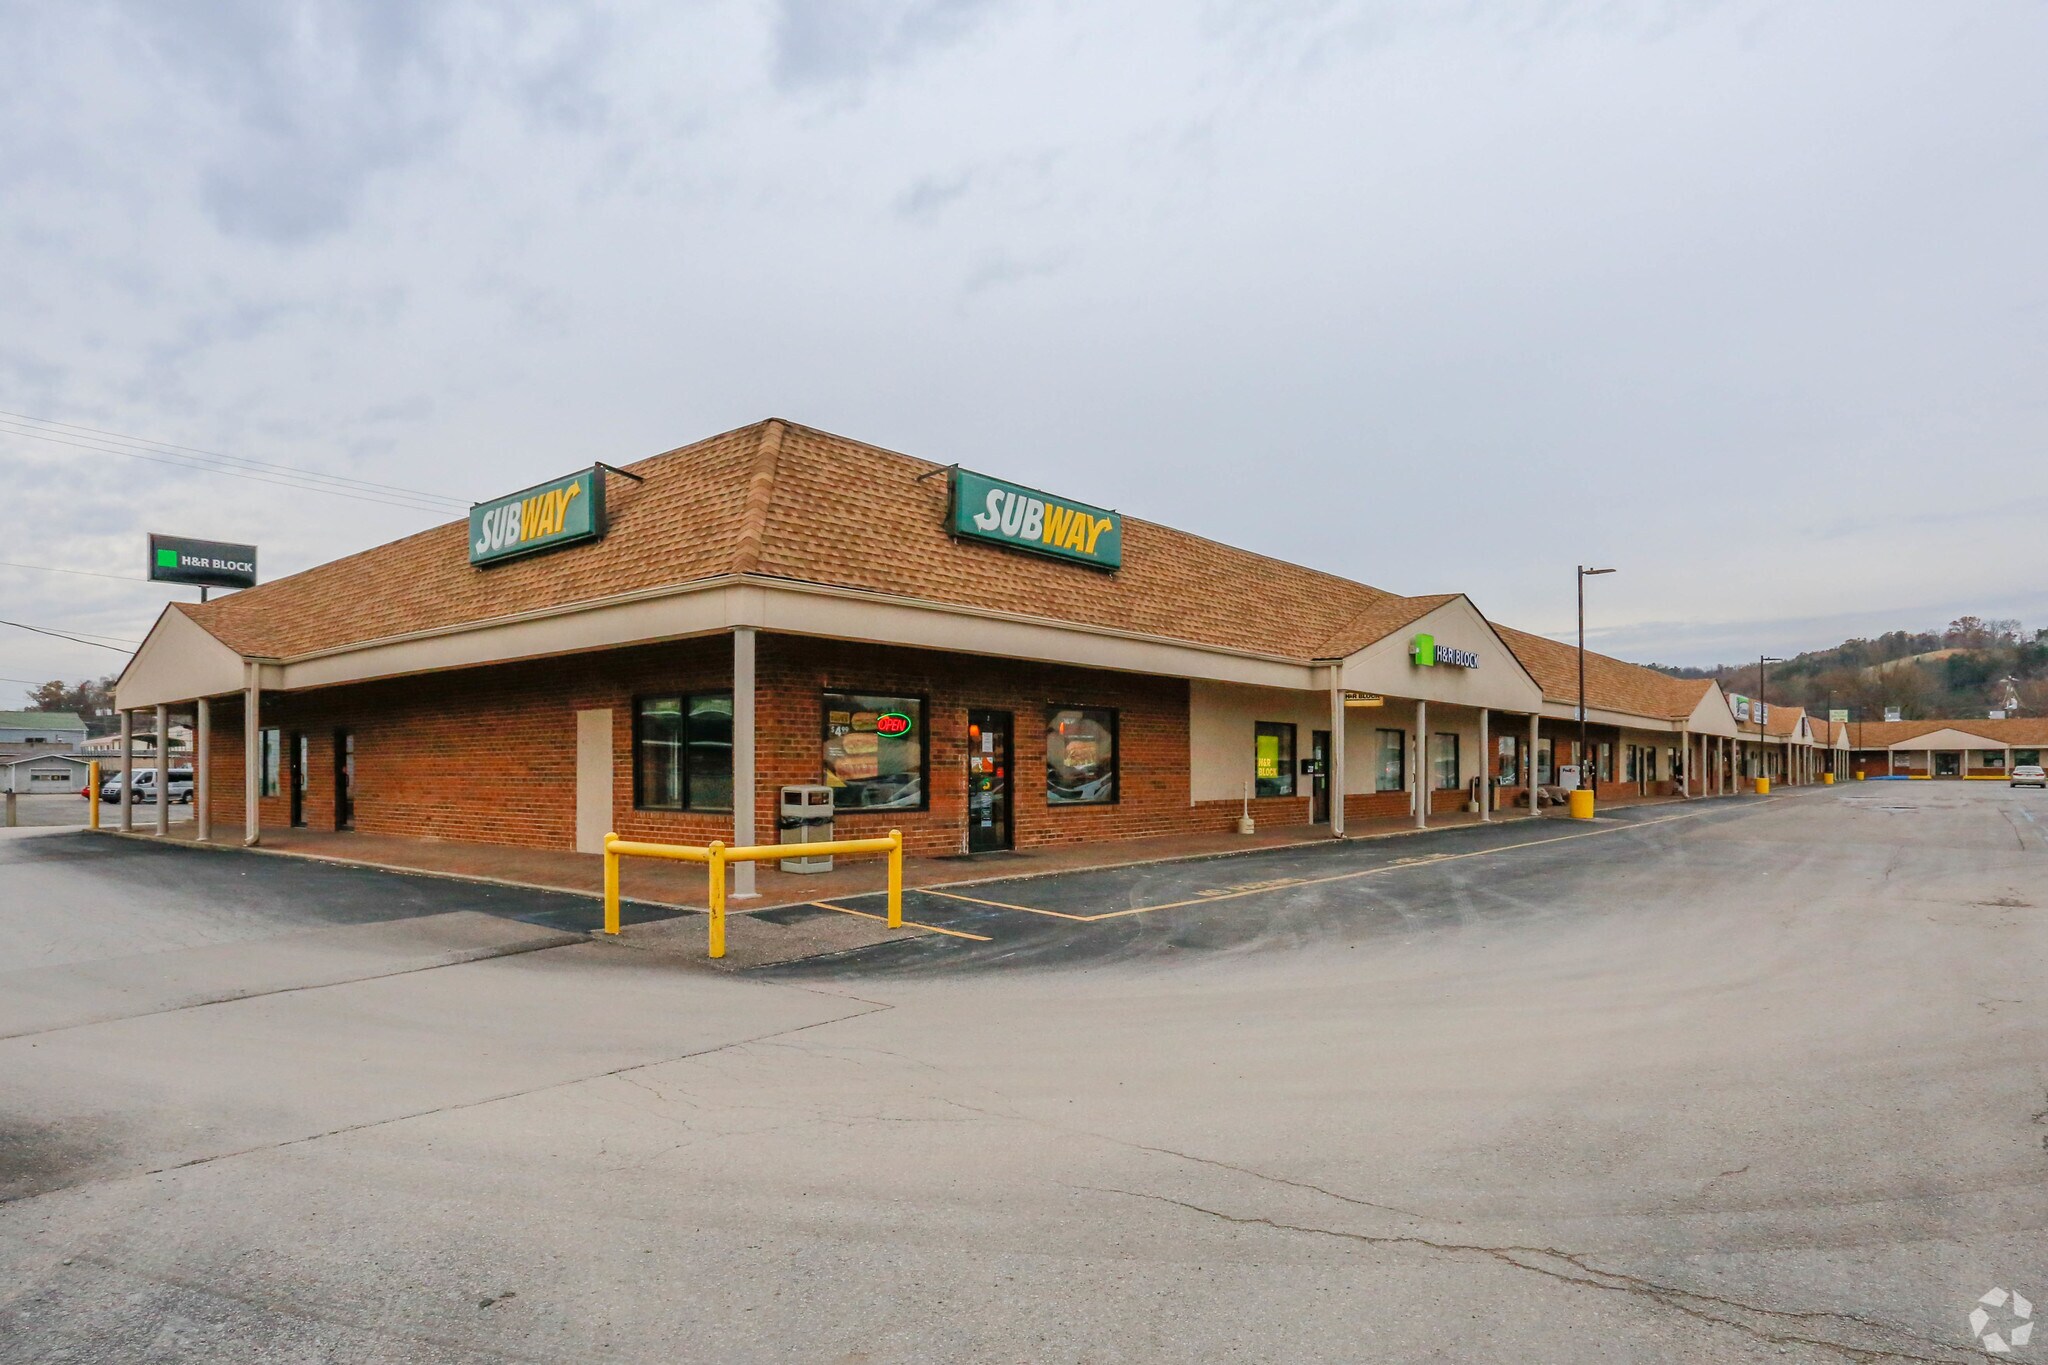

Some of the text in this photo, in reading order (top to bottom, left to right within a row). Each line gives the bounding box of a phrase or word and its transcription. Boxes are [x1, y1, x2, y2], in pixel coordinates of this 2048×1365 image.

[475, 480, 581, 556] SUBWAY
[973, 488, 1113, 556] SUBWAY
[181, 555, 253, 572] H&R BLOCK
[1436, 645, 1479, 669] H&R BLOCK
[878, 717, 907, 732] OPEN
[1258, 757, 1271, 767] H&R
[1258, 767, 1278, 776] BLOCK
